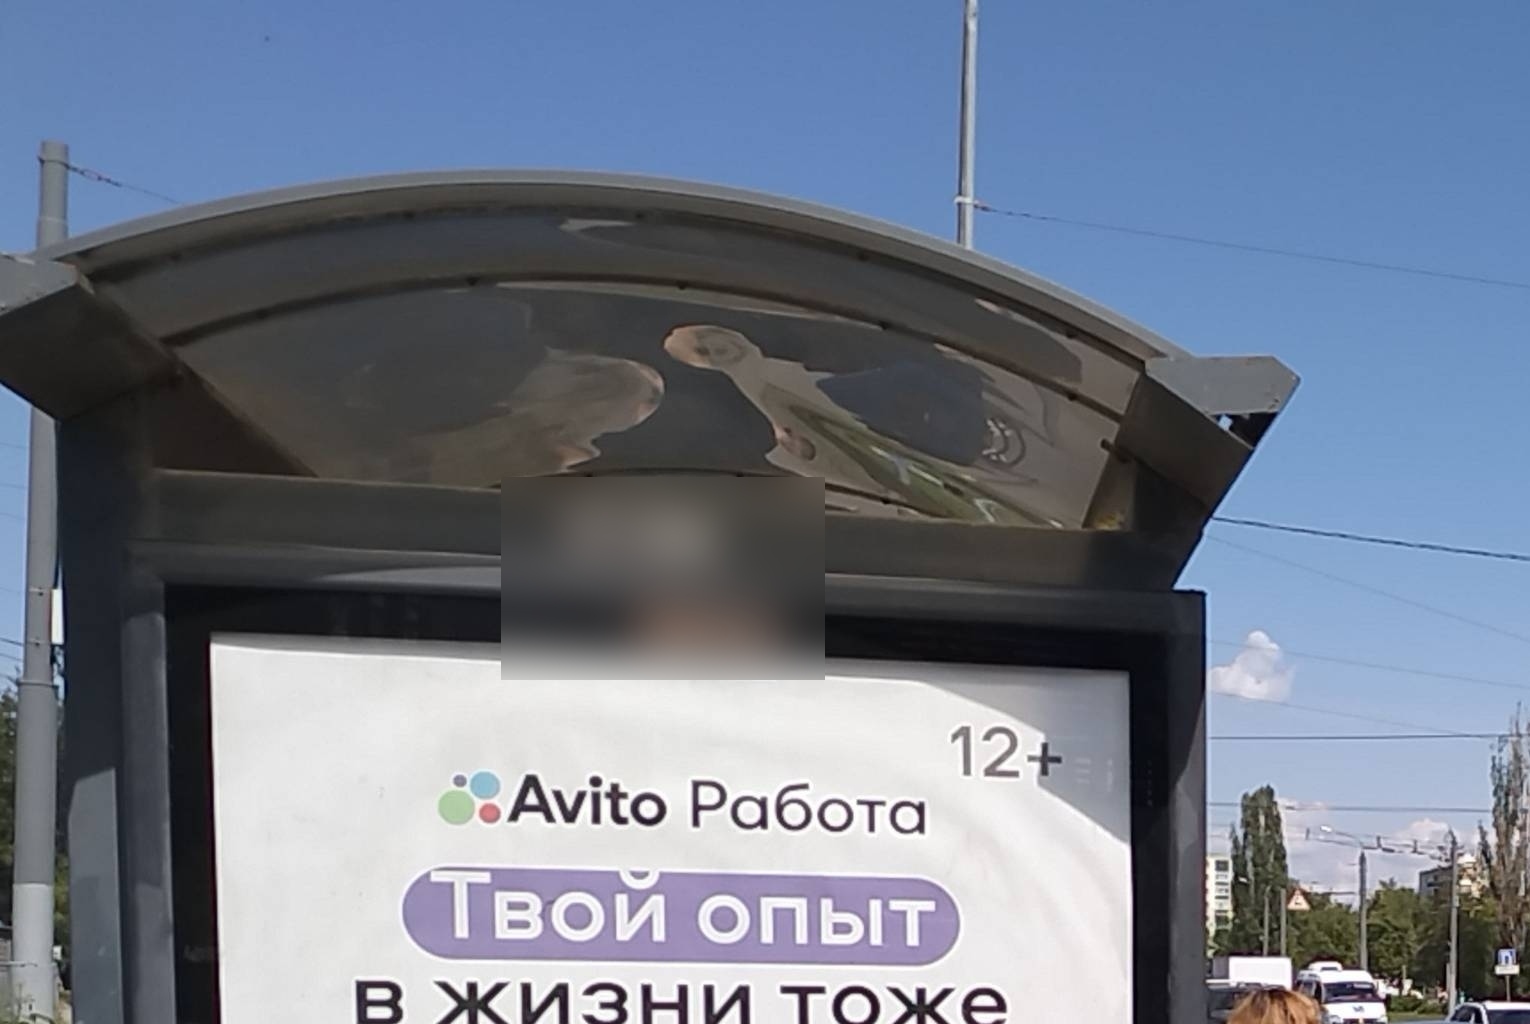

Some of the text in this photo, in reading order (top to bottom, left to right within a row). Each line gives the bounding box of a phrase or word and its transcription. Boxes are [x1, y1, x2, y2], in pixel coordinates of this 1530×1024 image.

[950, 725, 1063, 779] 12+
[507, 775, 927, 834] Avito Работа
[429, 869, 938, 949] Твой опыт
